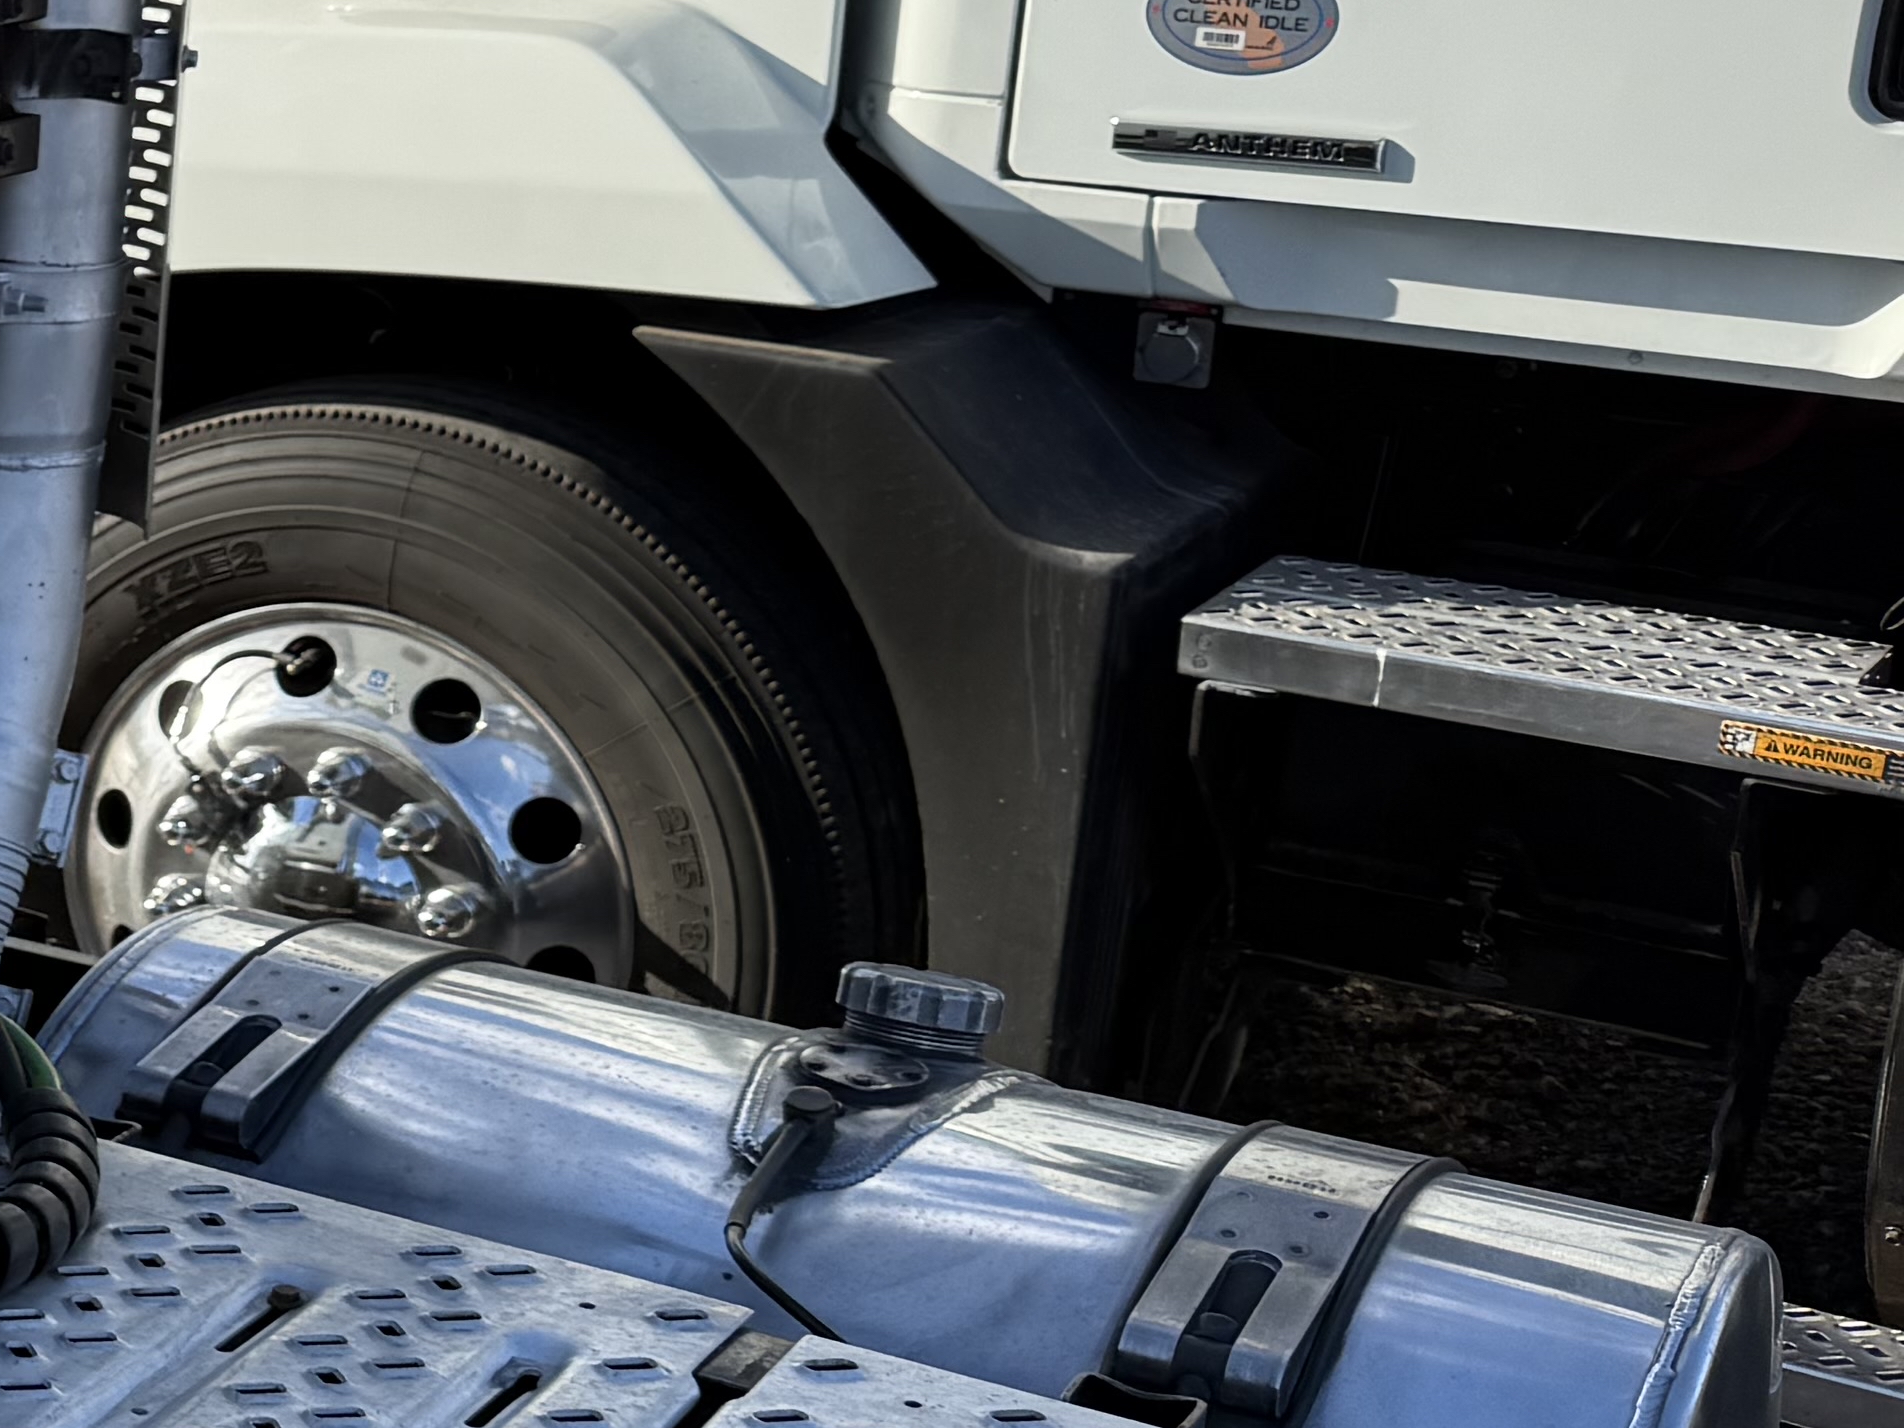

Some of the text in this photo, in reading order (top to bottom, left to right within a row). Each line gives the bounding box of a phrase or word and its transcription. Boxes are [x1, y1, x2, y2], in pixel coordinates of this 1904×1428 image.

[1172, 6, 1310, 33] CLEAN IDLE
[1189, 132, 1345, 162] ANTHEM
[1782, 740, 1874, 770] WARNING
